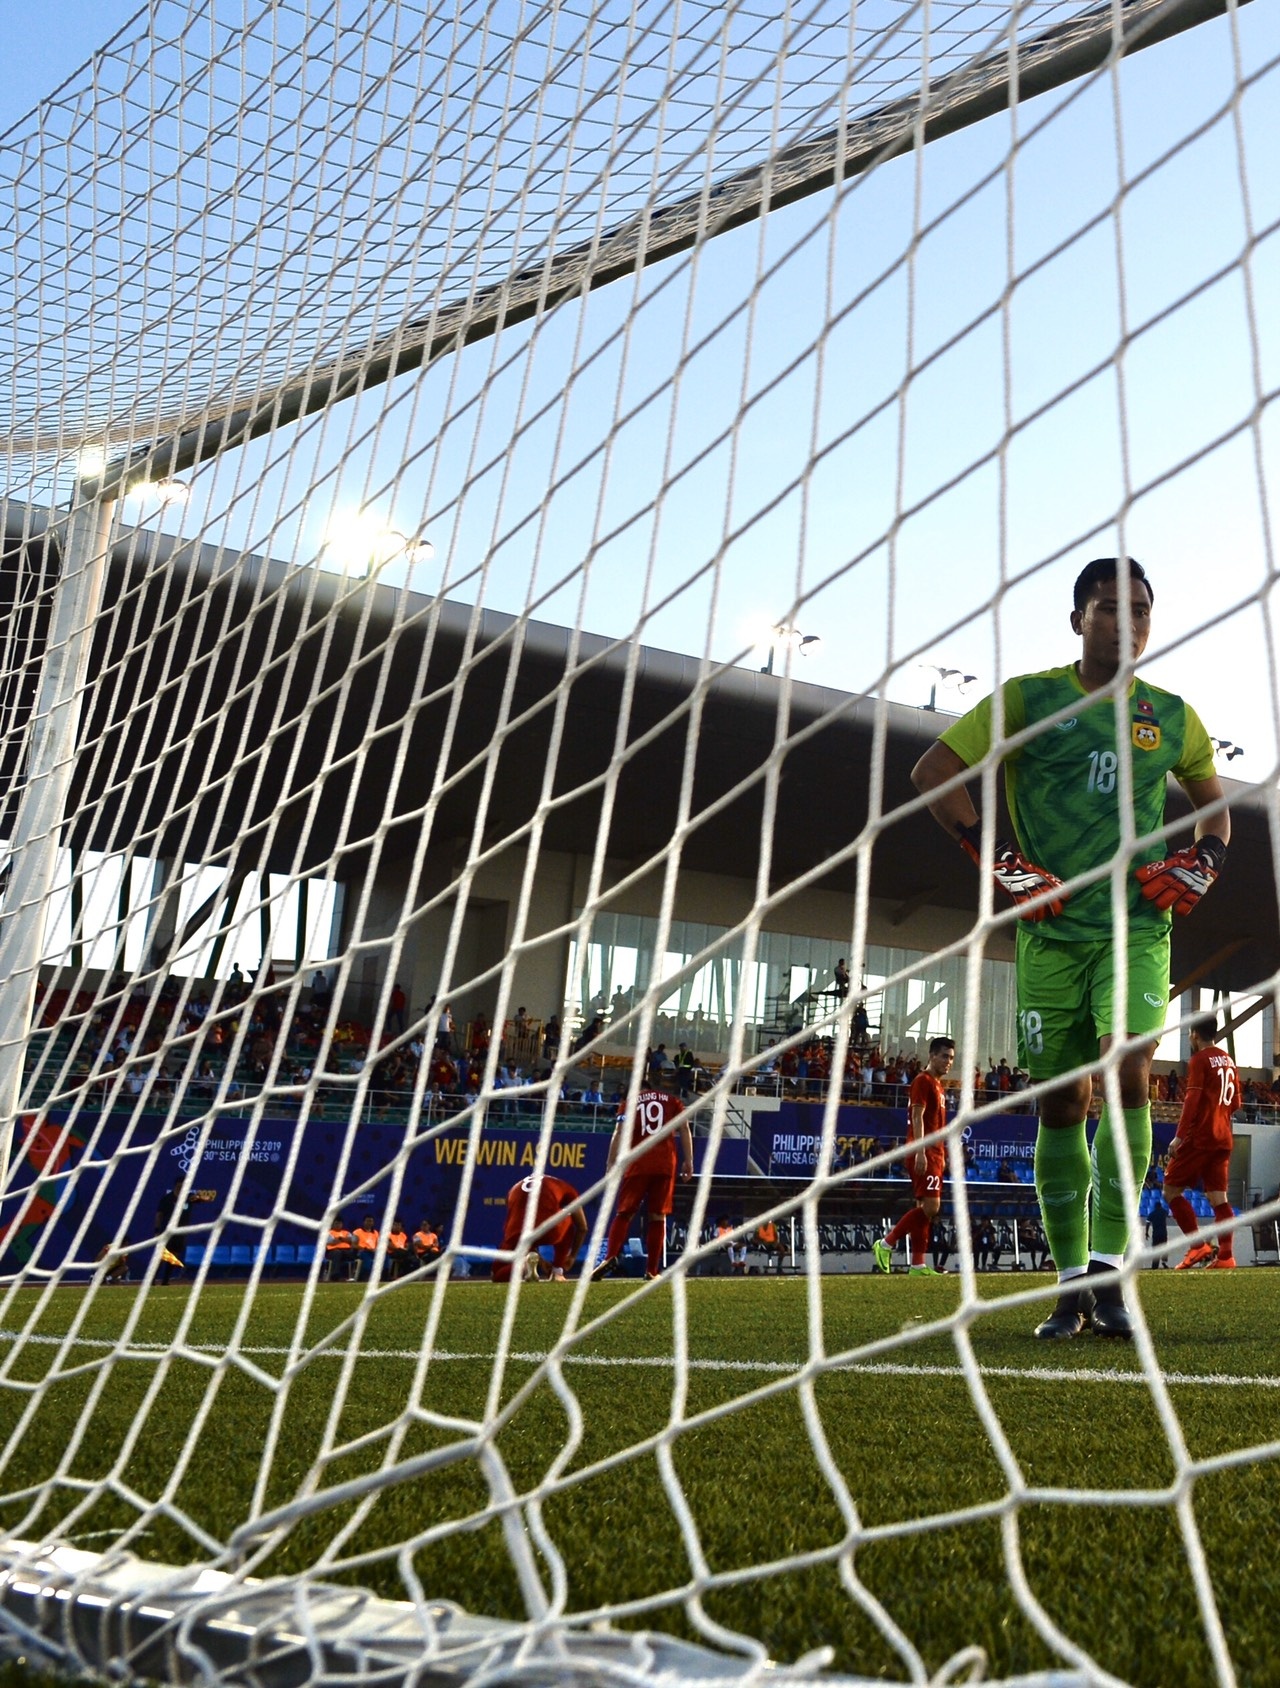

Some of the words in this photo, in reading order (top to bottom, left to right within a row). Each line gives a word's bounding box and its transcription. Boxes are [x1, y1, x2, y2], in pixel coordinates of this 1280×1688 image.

[1087, 750, 1118, 794] 18
[1019, 1009, 1044, 1055] 18
[1217, 1067, 1236, 1106] 16
[636, 1101, 664, 1136] 19
[205, 1139, 261, 1150] PHILIPPIES
[262, 1141, 282, 1151] 2019
[219, 1151, 236, 1161] SEA
[238, 1152, 269, 1162] MES
[435, 1138, 469, 1165] WE
[475, 1140, 517, 1166] WIN
[551, 1142, 587, 1168] ONE
[791, 1152, 808, 1165] SEA
[926, 1175, 941, 1190] 22
